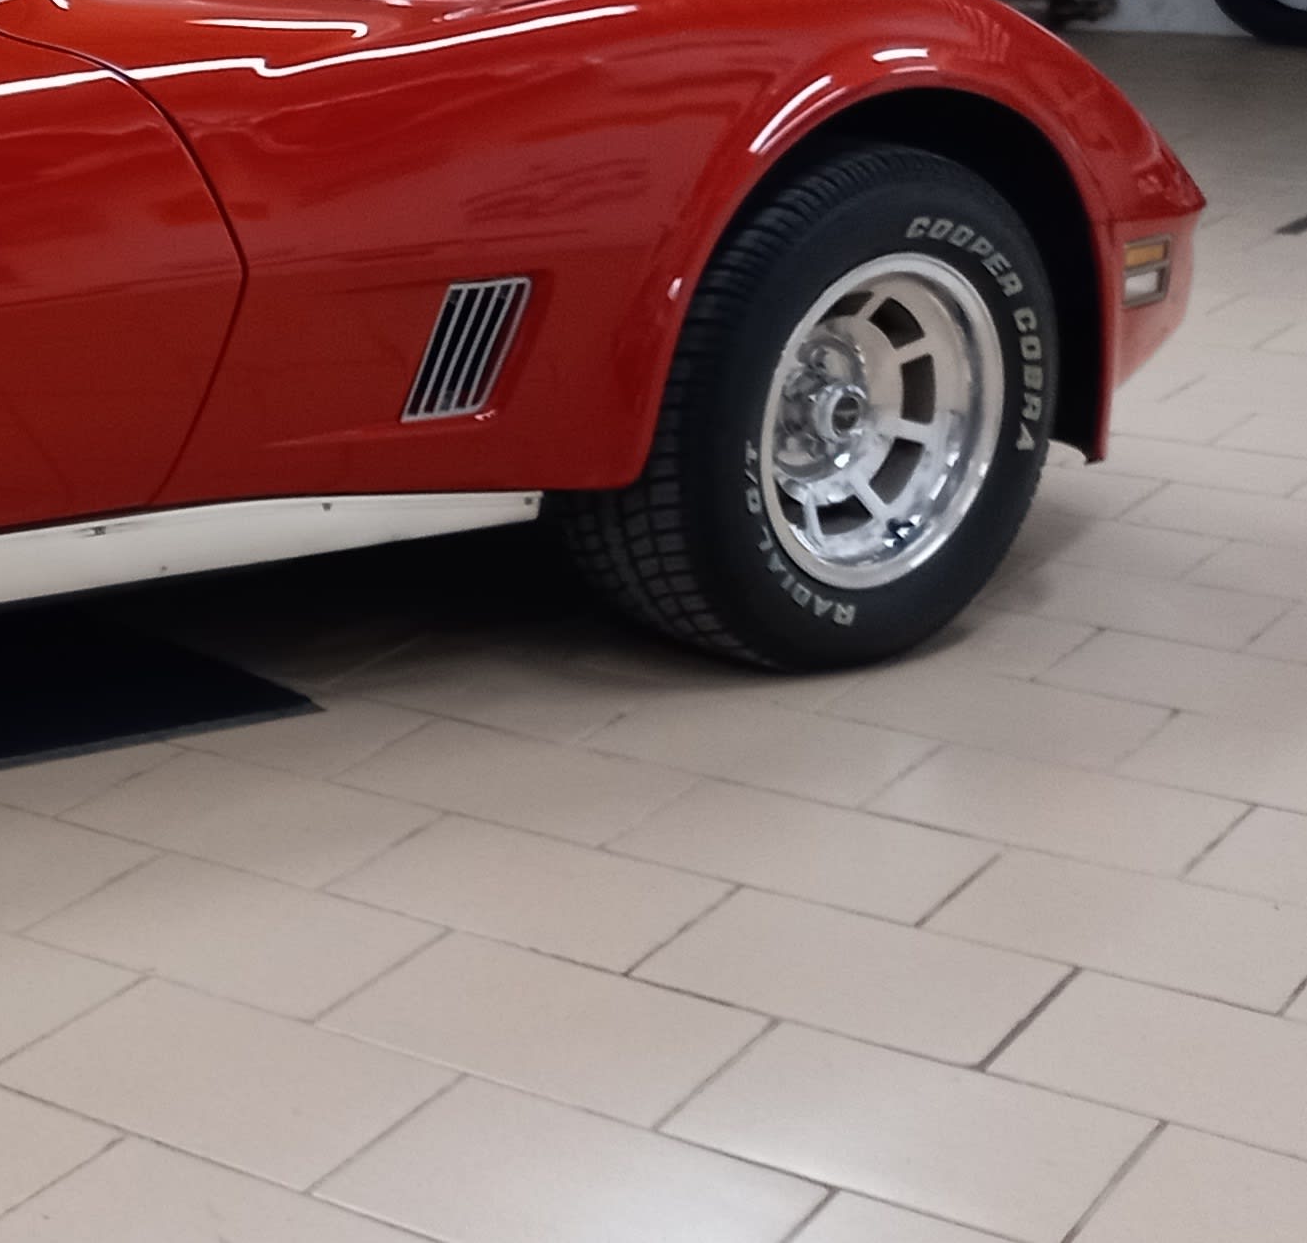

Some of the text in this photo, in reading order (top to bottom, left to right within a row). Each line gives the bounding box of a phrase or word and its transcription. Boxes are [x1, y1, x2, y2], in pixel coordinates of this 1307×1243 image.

[905, 215, 1044, 451] COOPER COBRA
[757, 525, 856, 627] RADIAL
